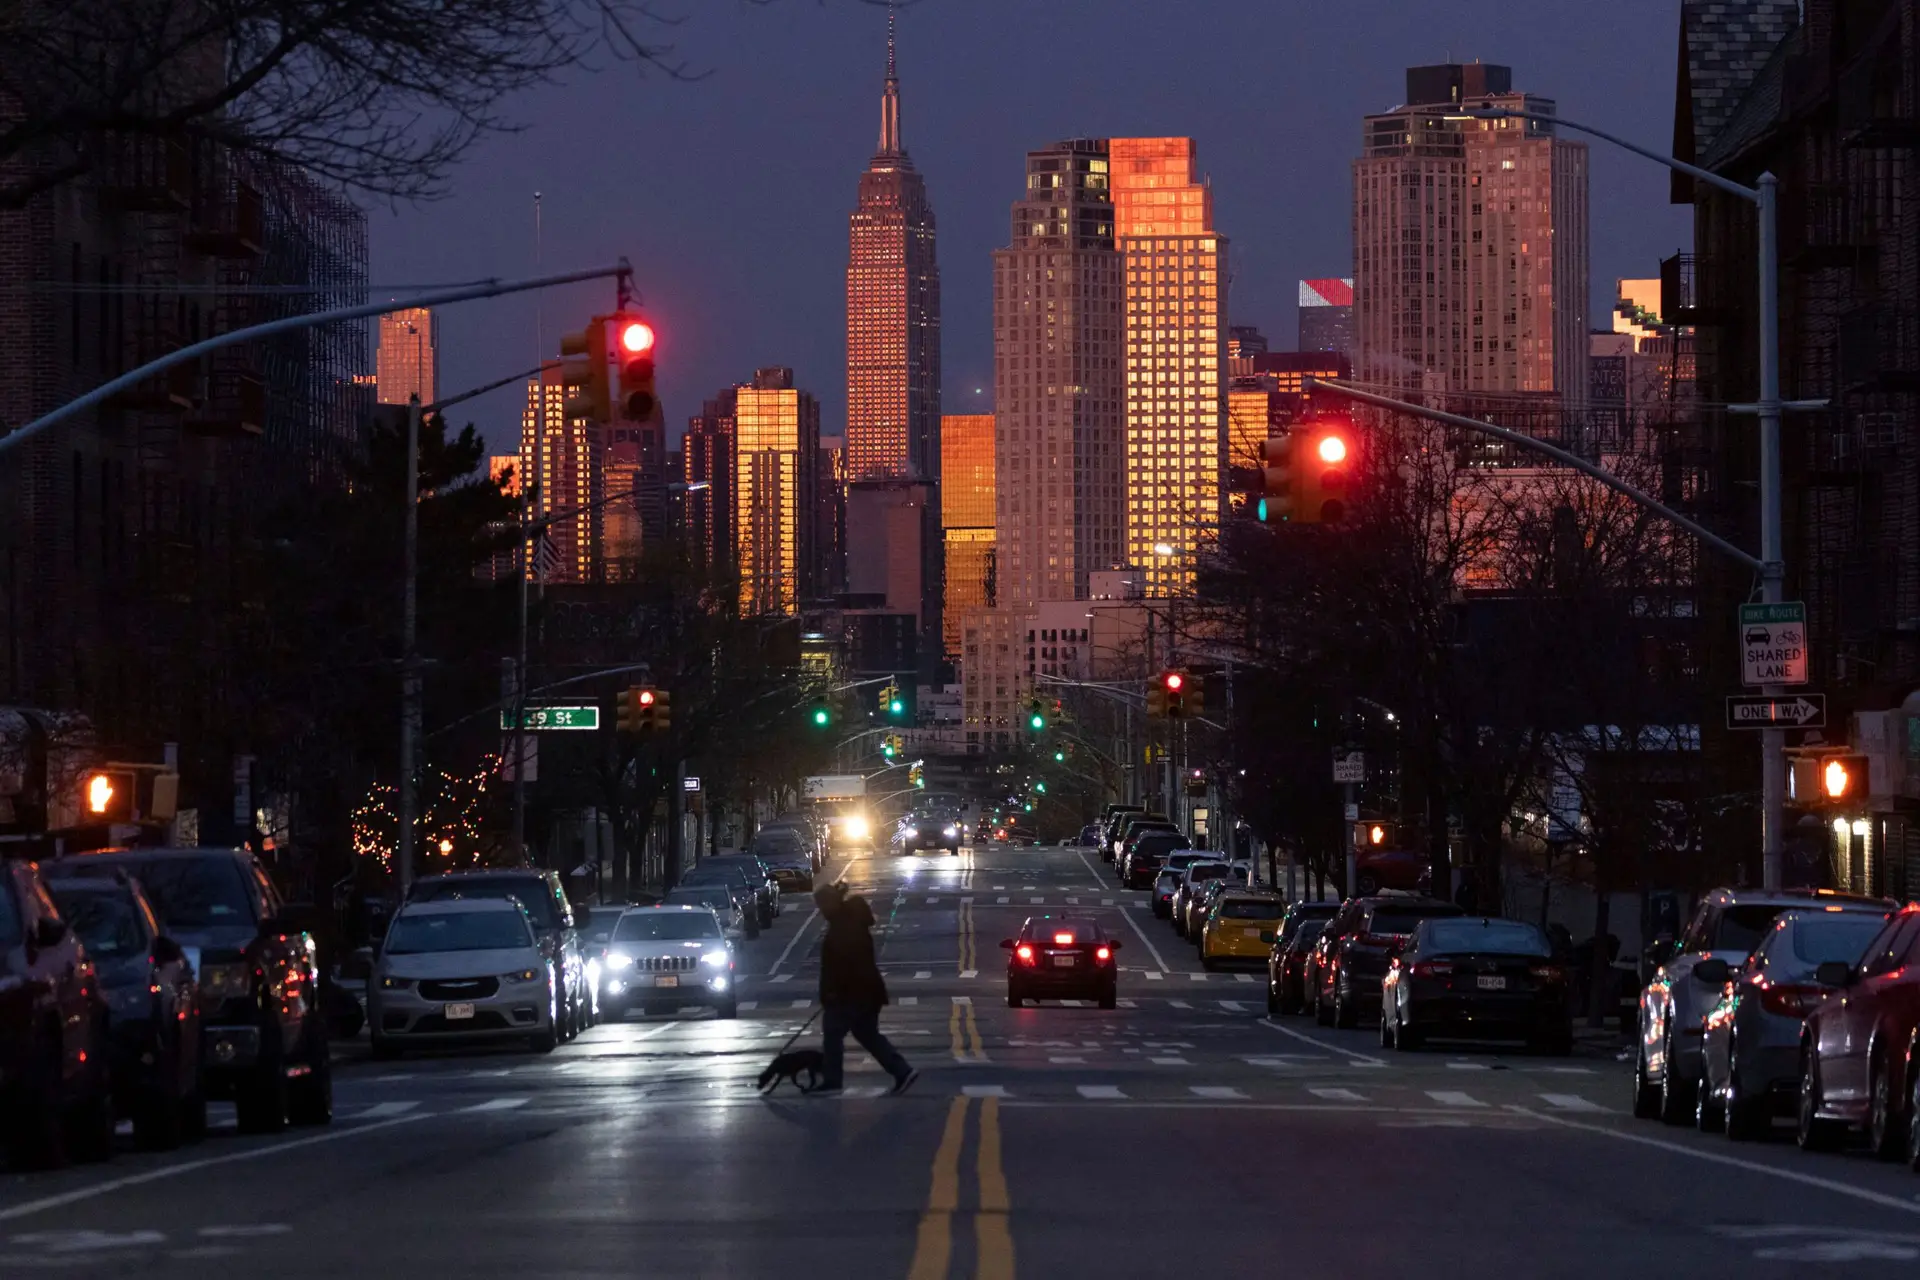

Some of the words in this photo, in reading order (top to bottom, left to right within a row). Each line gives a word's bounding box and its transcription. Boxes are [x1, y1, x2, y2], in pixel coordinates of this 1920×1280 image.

[1608, 359, 1623, 367] THE
[1607, 387, 1625, 397] ALL
[1769, 606, 1799, 619] ROUTE
[1747, 648, 1801, 663] SHARED
[1756, 664, 1793, 678] LANE
[527, 711, 547, 725] 39
[555, 711, 572, 725] St
[1741, 705, 1769, 719] ONE
[1781, 704, 1810, 717] WAY
[1336, 764, 1362, 772] SHARED
[1660, 899, 1670, 915] P
